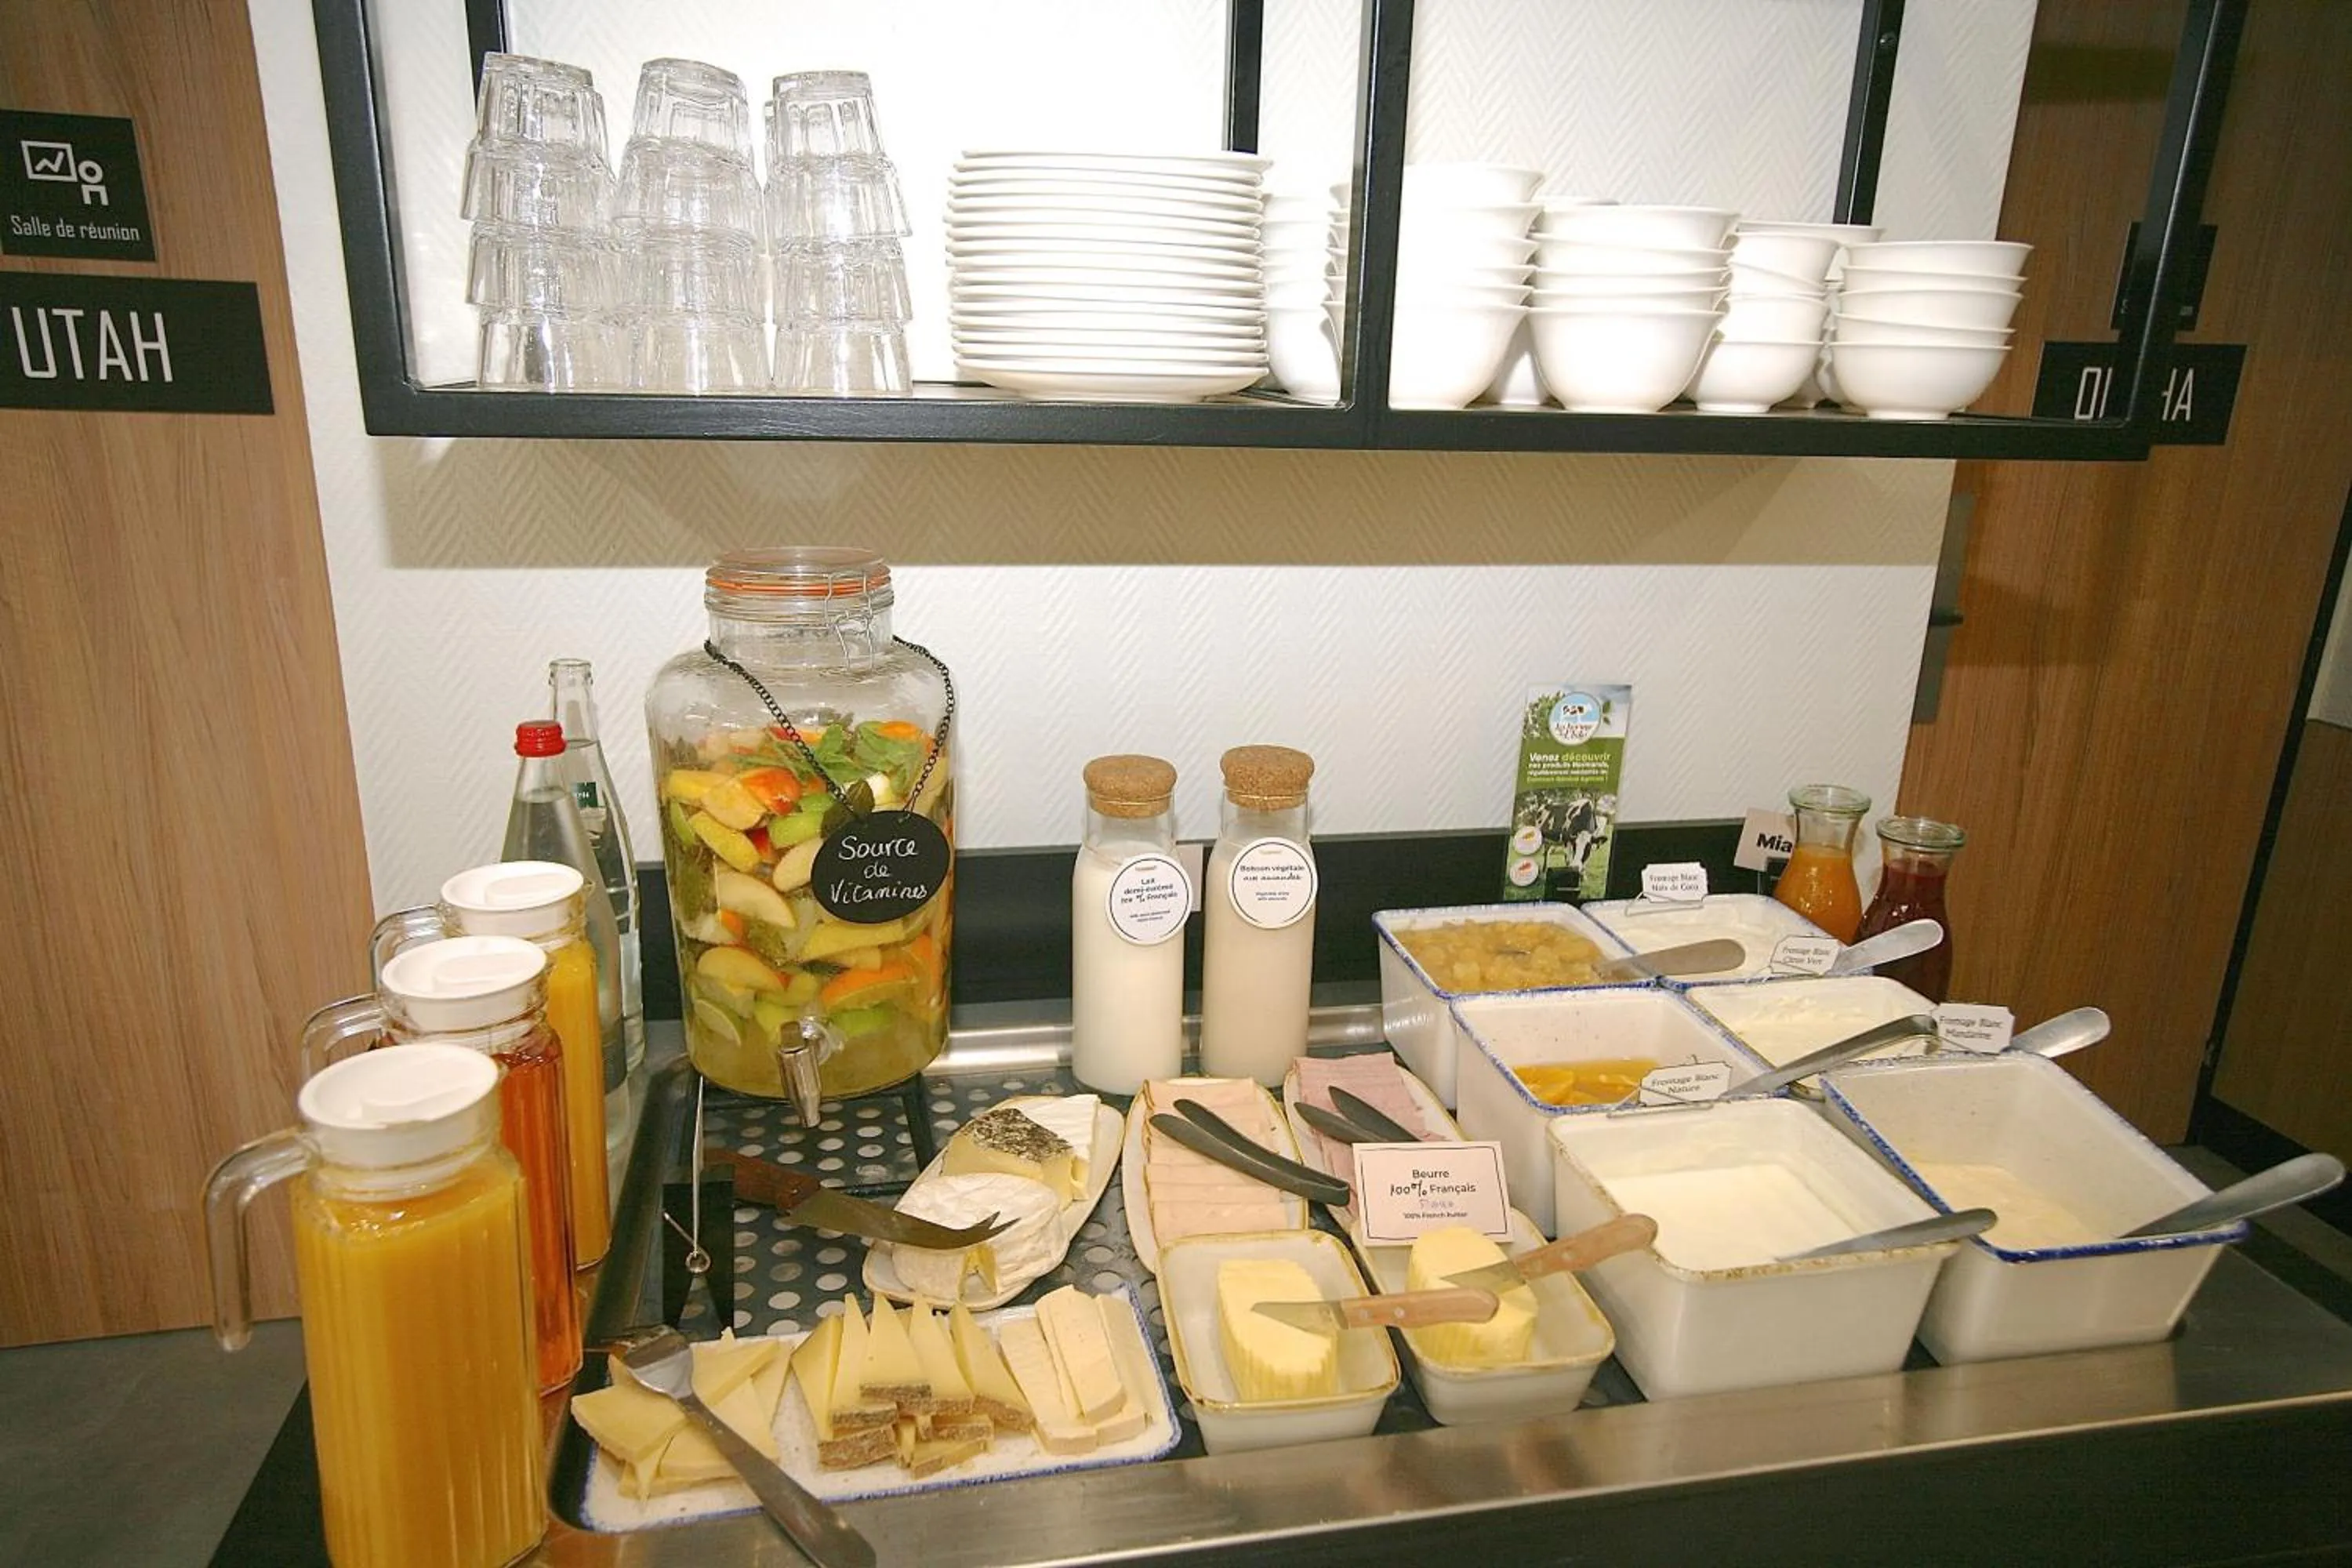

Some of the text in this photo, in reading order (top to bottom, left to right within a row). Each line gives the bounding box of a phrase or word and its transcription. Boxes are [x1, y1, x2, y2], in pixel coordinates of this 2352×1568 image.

[9, 214, 140, 241] Salle de réunion
[11, 306, 173, 383] UTAH
[1530, 752, 1611, 762] Venez découvrir
[838, 835, 919, 861] Source
[863, 862, 891, 879] de
[829, 878, 928, 905] Vitamines
[1651, 1076, 1693, 1087] Fromage
[1412, 1169, 1450, 1178] Beurre
[1429, 1182, 1476, 1196] Français
